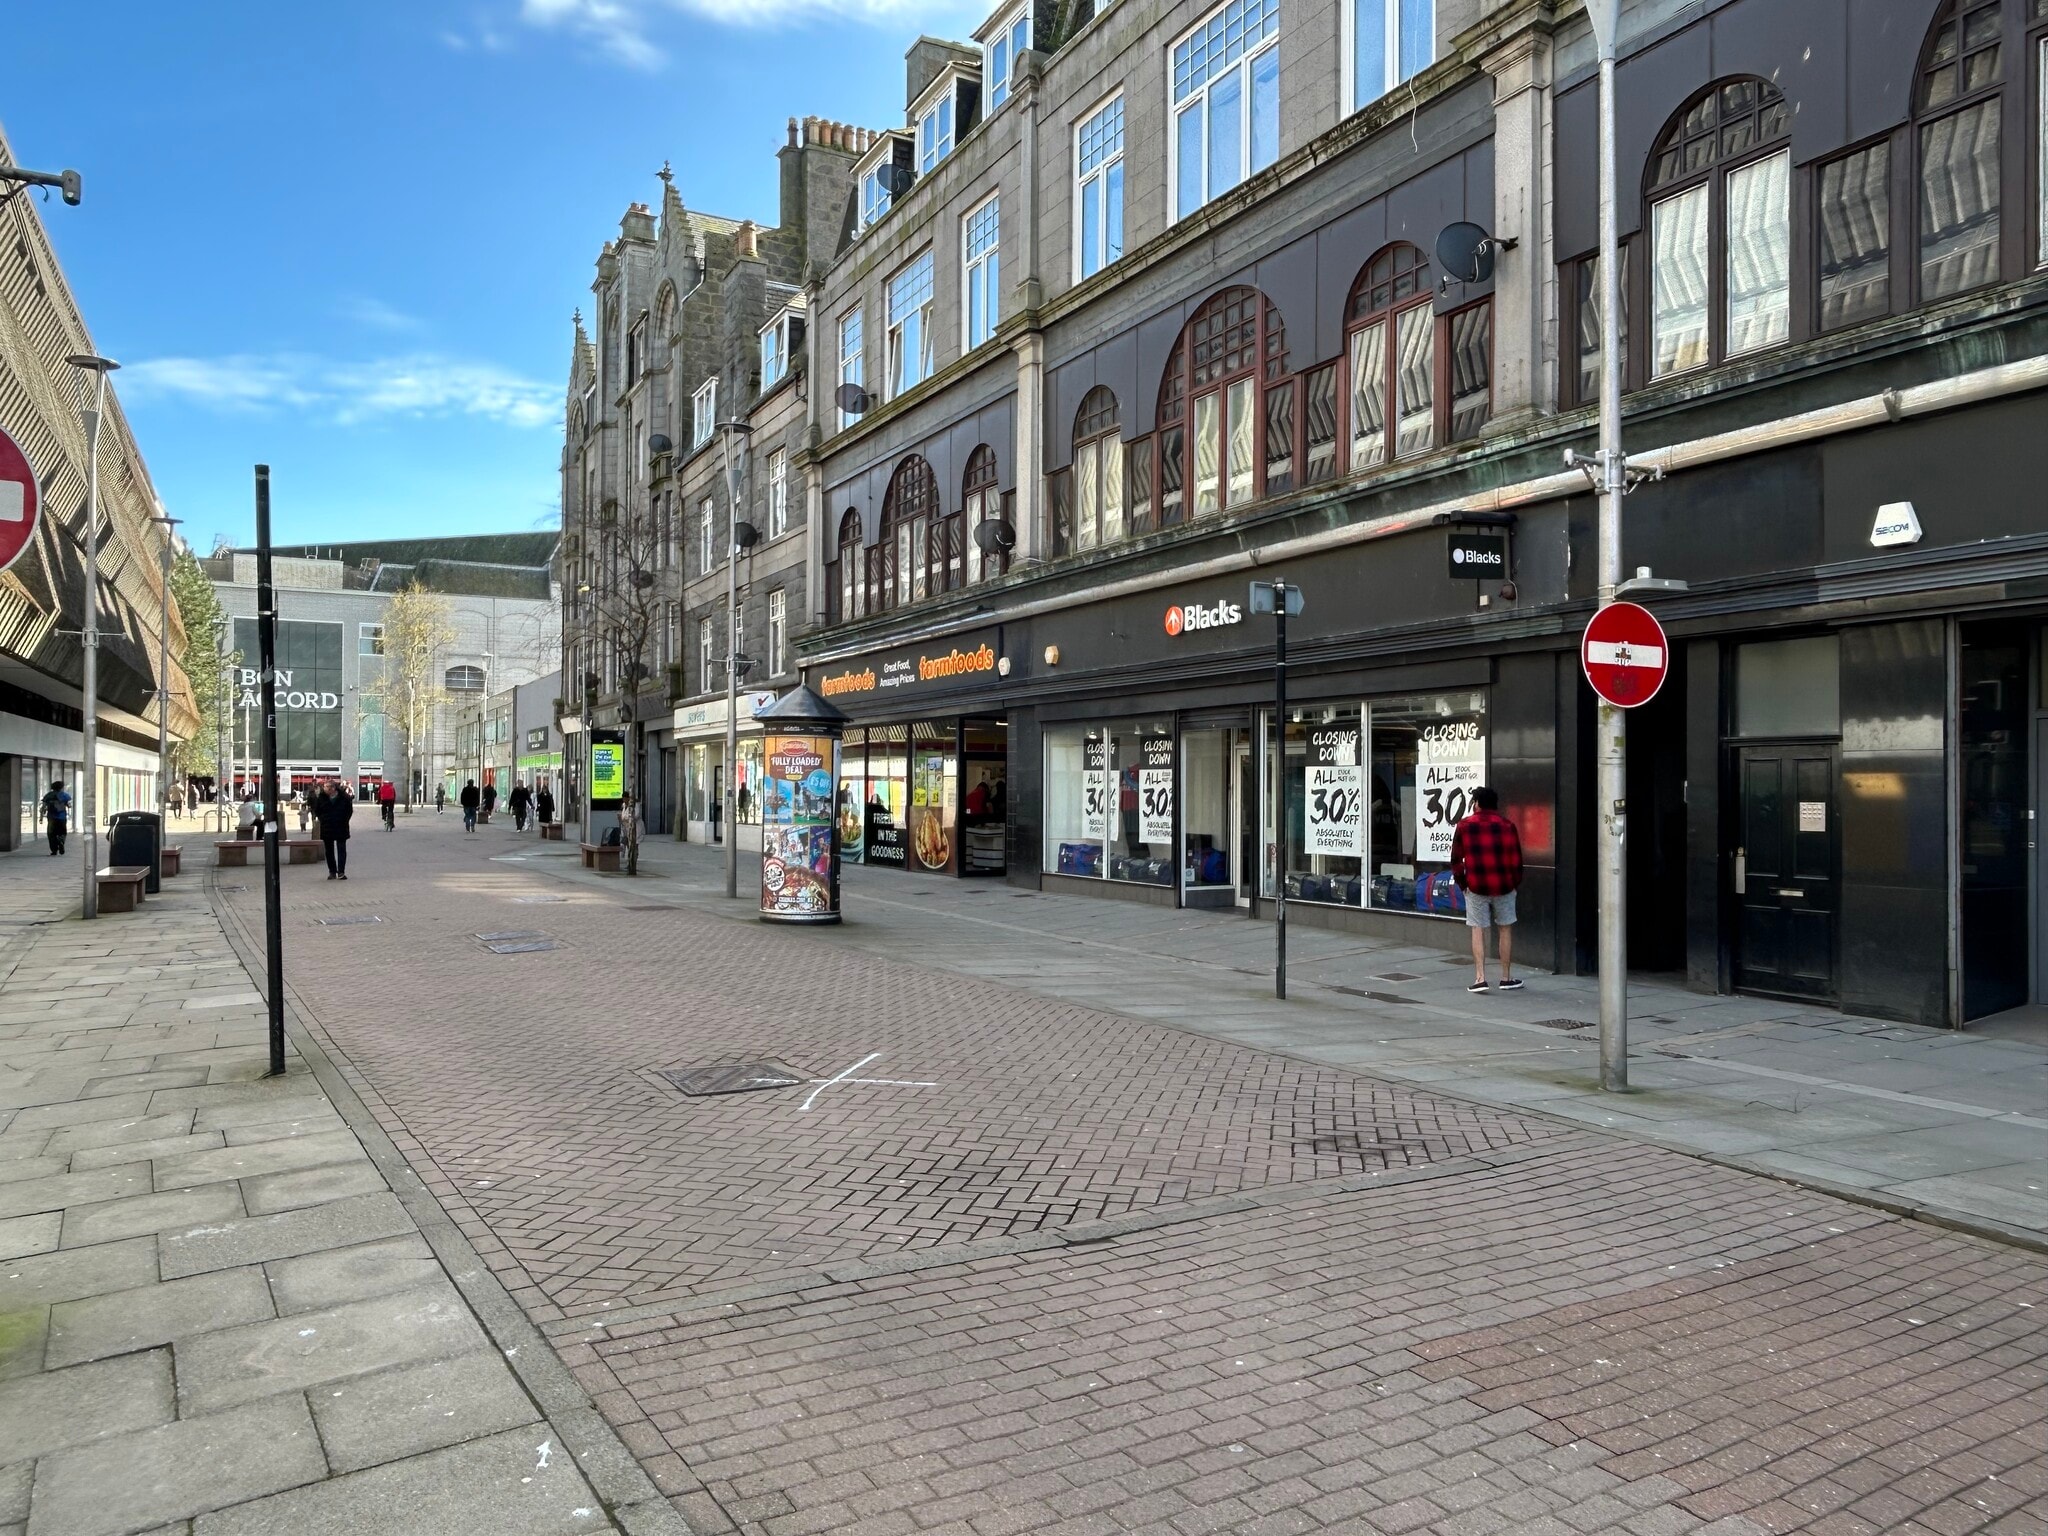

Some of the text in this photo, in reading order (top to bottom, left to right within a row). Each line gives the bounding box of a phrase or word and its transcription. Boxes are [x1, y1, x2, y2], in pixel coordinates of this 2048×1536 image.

[1875, 523, 1909, 536] SECOM
[1465, 550, 1502, 565] Blacks
[1184, 600, 1242, 632] Blacks
[884, 663, 897, 674] Great
[919, 643, 994, 681] farmfoods
[240, 668, 293, 687] BN
[821, 668, 876, 697] farmfoods
[879, 673, 915, 688] Amazing Prices
[239, 690, 338, 709] ACORD
[1312, 730, 1358, 745] CLOSING
[1424, 722, 1479, 741] CLOSING
[1087, 743, 1115, 754] CLOSG
[1144, 740, 1173, 752] CLOSIN
[1319, 746, 1350, 761] DOWN
[1432, 740, 1470, 758] DOWN
[771, 757, 791, 766] FULLY
[1148, 753, 1171, 765] DOWN
[785, 766, 804, 774] DEAL
[1314, 769, 1337, 786] ALL
[1427, 767, 1453, 785] ALL
[1088, 771, 1103, 785] ALL
[1145, 771, 1161, 785] ALL
[1310, 788, 1359, 825] 30%
[1343, 814, 1360, 825] OFF
[878, 830, 898, 842] IN THE
[1315, 828, 1354, 838] ABSOLUTELY
[1430, 833, 1452, 841] ABSOL
[1317, 838, 1353, 848] EVERYTHING
[871, 845, 904, 860] GOODNESS
